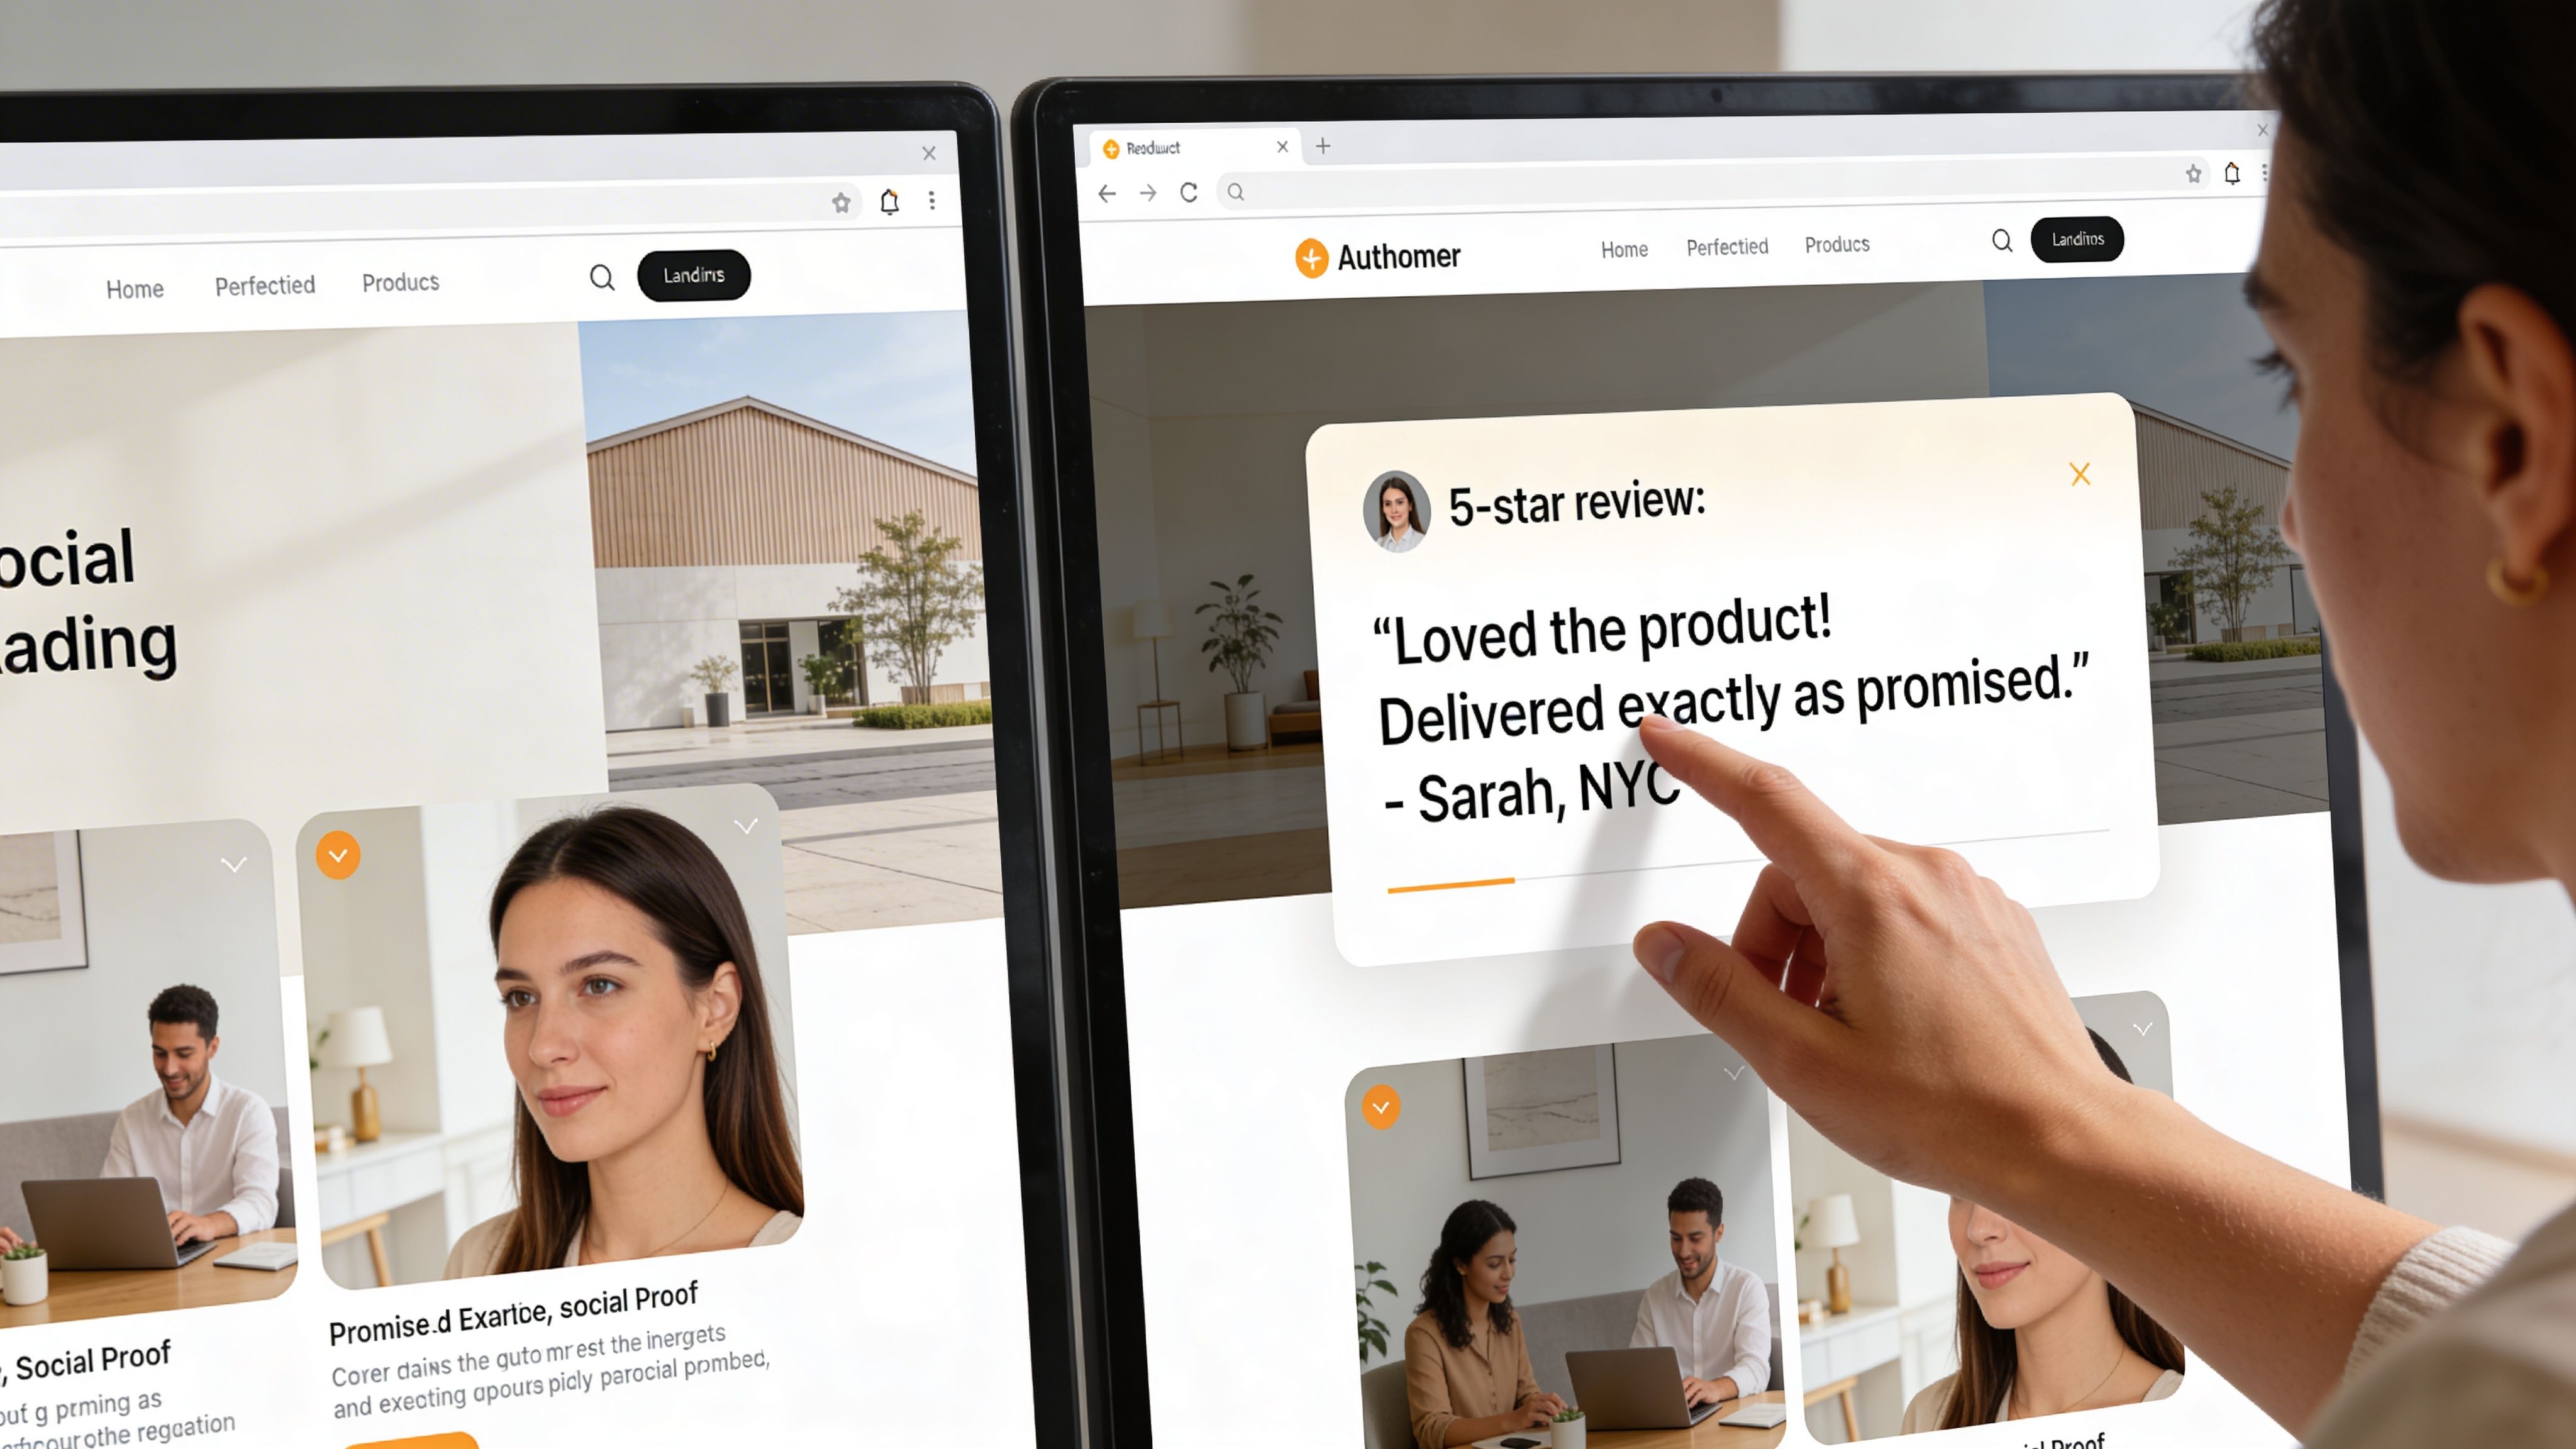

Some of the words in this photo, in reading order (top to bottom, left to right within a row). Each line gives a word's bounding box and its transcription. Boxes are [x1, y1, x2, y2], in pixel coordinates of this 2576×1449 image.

[1338, 243, 1462, 270] Authomer
[1602, 241, 1648, 258] Home
[1687, 237, 1769, 257] Perfectied
[1806, 235, 1870, 253] Producs
[107, 279, 164, 299] Home
[216, 274, 316, 297] Perfectied
[363, 272, 440, 292] Producs
[1450, 487, 1565, 527] 5-star
[1576, 479, 1706, 521] review:
[0, 614, 177, 681] ading
[1374, 609, 1536, 665] “Loved
[1550, 607, 1626, 654] the
[1640, 591, 1831, 662] product!
[1380, 684, 1604, 745] Delivered
[1618, 673, 1781, 731] exactly
[1794, 678, 1845, 716] as
[1858, 651, 2089, 724] promised.”
[1385, 801, 1404, 809] -
[1419, 767, 1565, 823] Sarah,
[1580, 760, 1680, 811] NYC
[560, 1288, 628, 1319] social
[636, 1279, 699, 1311] Proof
[16, 1348, 94, 1380] Social
[102, 1338, 171, 1371] Proof
[457, 1352, 489, 1372] the
[611, 1335, 641, 1354] the
[138, 1392, 162, 1409] as
[334, 1395, 372, 1419] and
[601, 1358, 677, 1391] parocial
